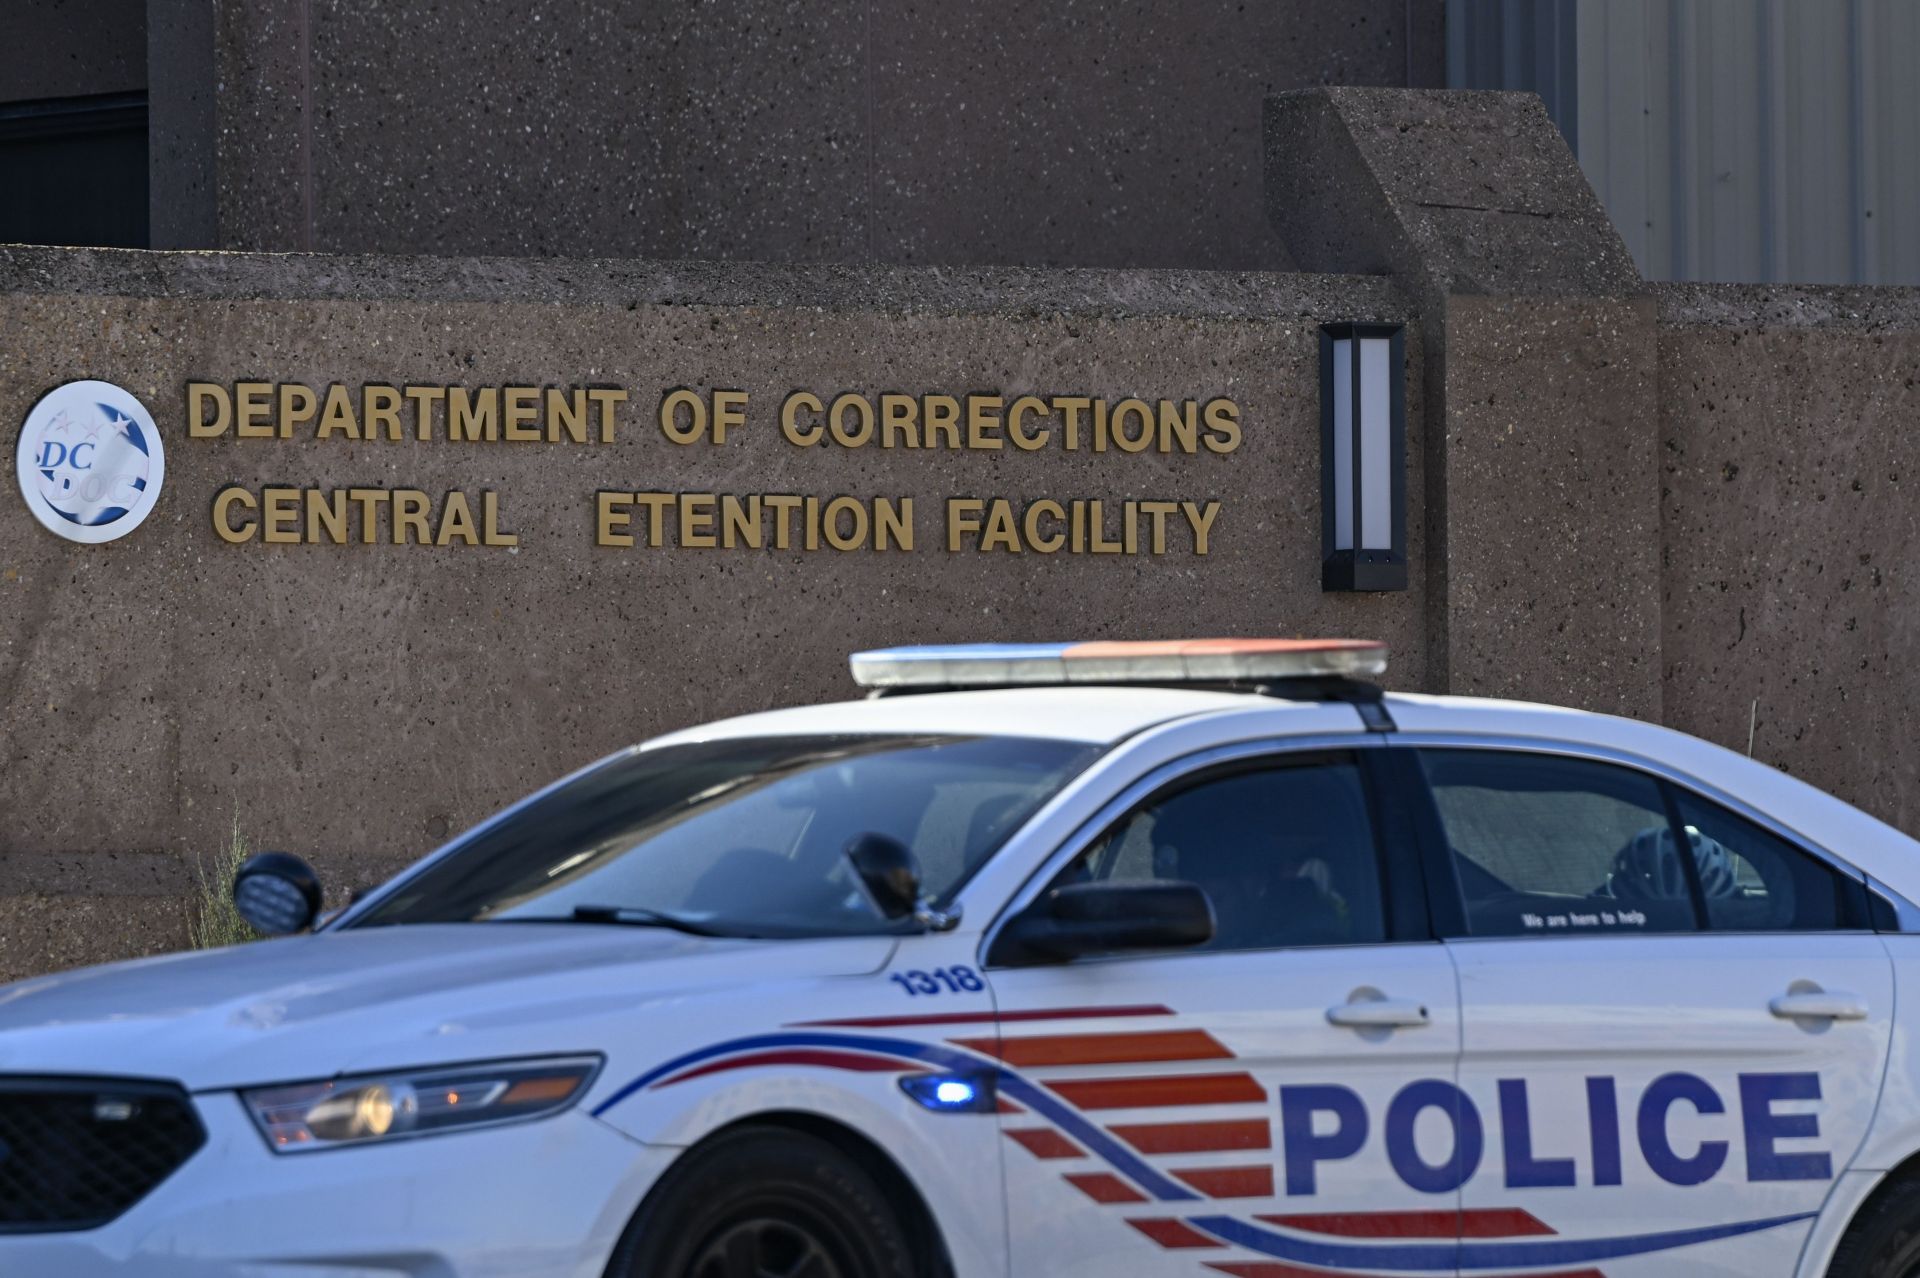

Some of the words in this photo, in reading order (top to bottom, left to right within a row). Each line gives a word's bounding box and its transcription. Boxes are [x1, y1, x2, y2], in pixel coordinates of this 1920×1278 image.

[187, 382, 627, 442] DEPARTMENT
[660, 389, 748, 444] OF
[781, 392, 1242, 453] CORRECTIONS
[38, 441, 95, 470] DC
[212, 486, 517, 546] CENTRAL
[596, 491, 913, 551] ETENTION
[948, 498, 1220, 555] FACILITY
[1521, 913, 1544, 927] We
[1547, 915, 1568, 927] are
[1569, 911, 1600, 926] here
[1601, 911, 1616, 925] to
[1617, 909, 1647, 926] help
[890, 965, 984, 995] 1318
[1279, 1072, 1833, 1196] POLICE
